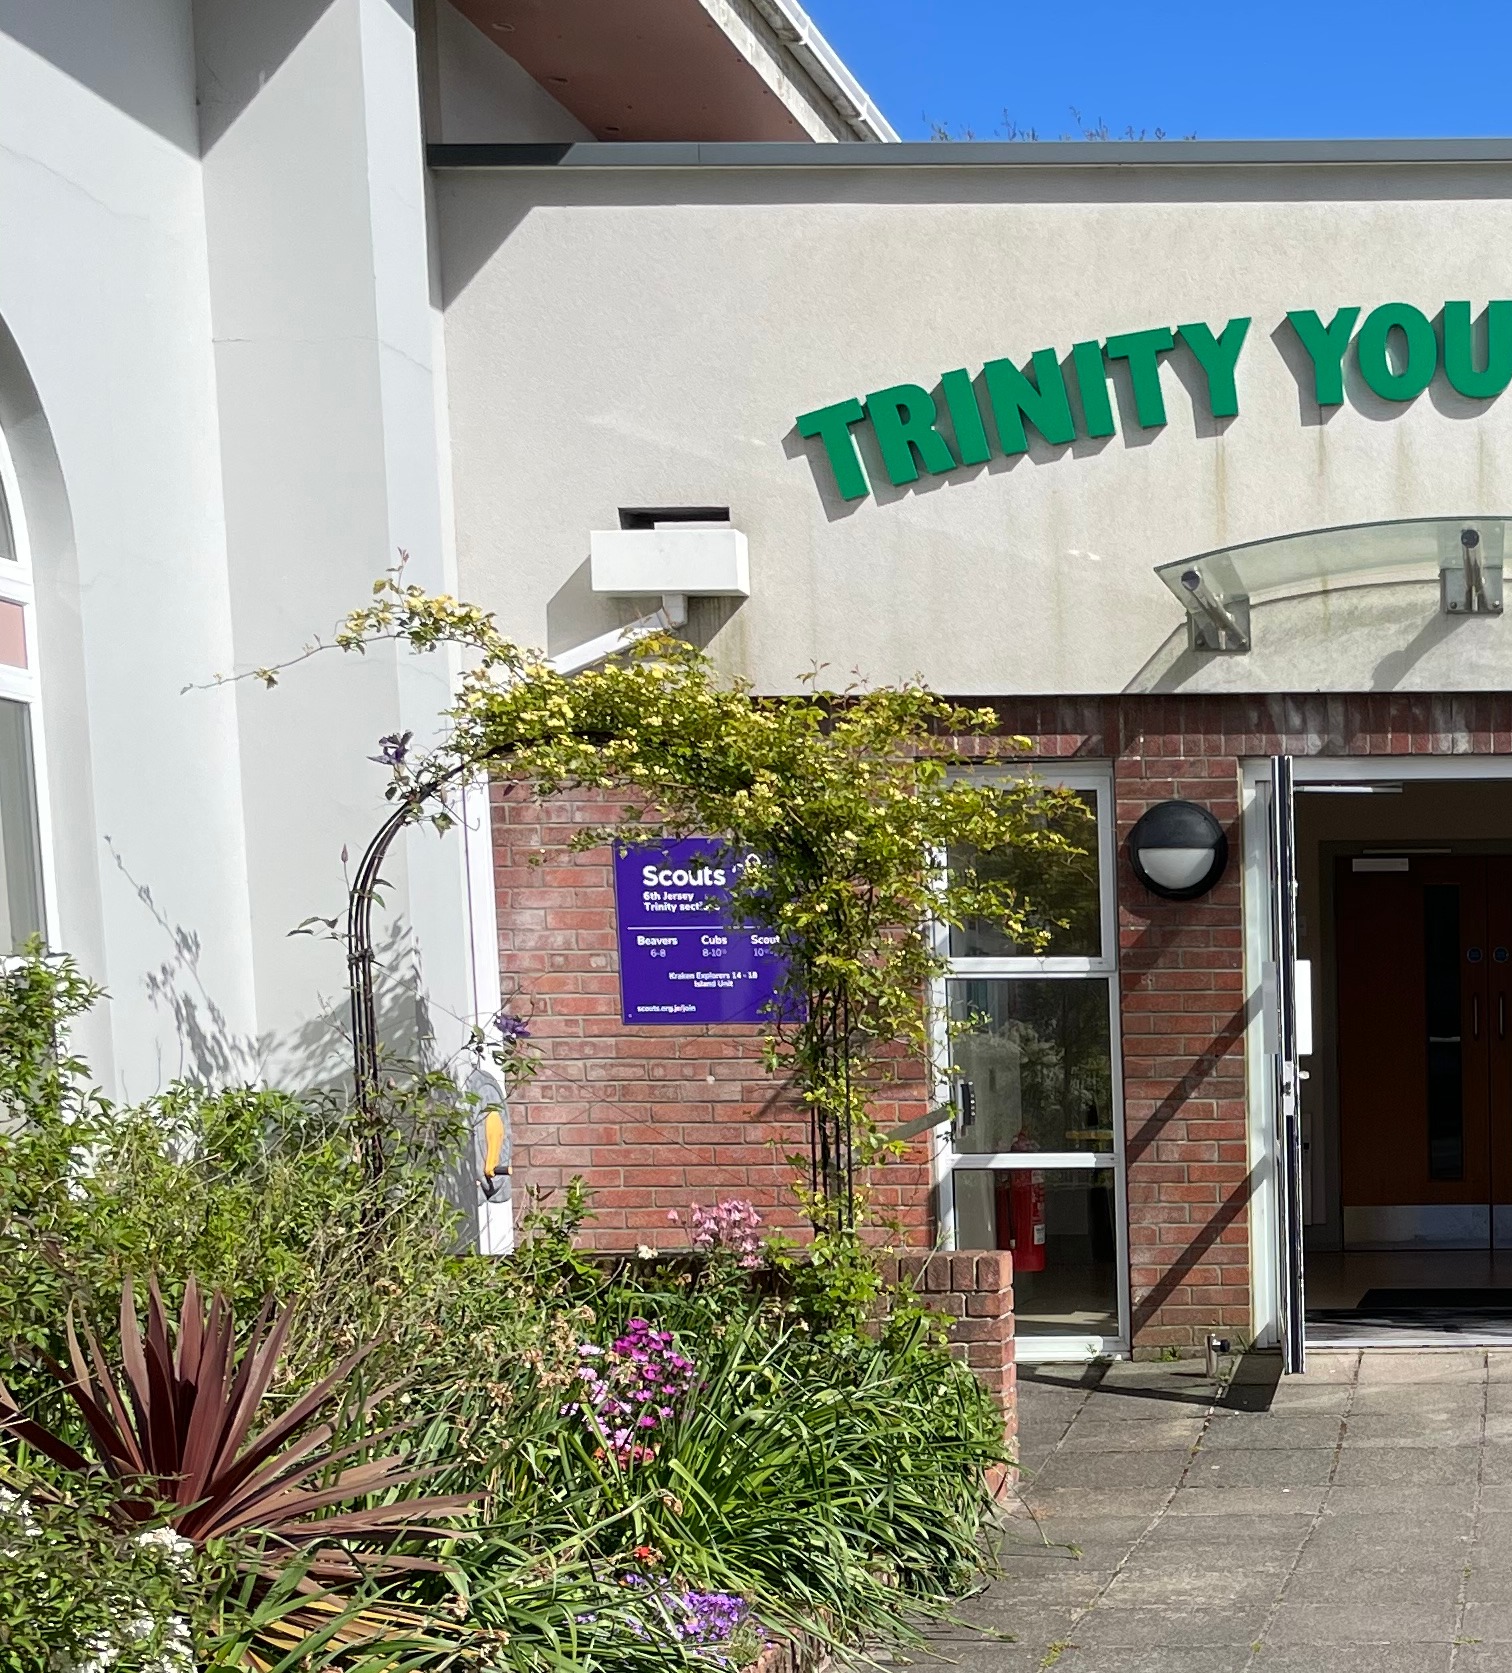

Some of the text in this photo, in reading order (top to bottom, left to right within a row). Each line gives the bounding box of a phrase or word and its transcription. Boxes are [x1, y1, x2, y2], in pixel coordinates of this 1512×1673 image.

[796, 317, 1252, 502] TRINITY
[642, 865, 726, 887] Scouts
[642, 891, 694, 902] 6th Jersey
[643, 901, 721, 913] Trinity sect
[637, 935, 678, 946] Beavers
[701, 935, 728, 945] Cubs
[750, 934, 780, 945] Scout
[650, 948, 666, 958] 6-8
[668, 972, 695, 980] Kraken
[696, 971, 730, 981] Explorers
[732, 972, 742, 980] 14
[693, 980, 734, 988] Island Unit
